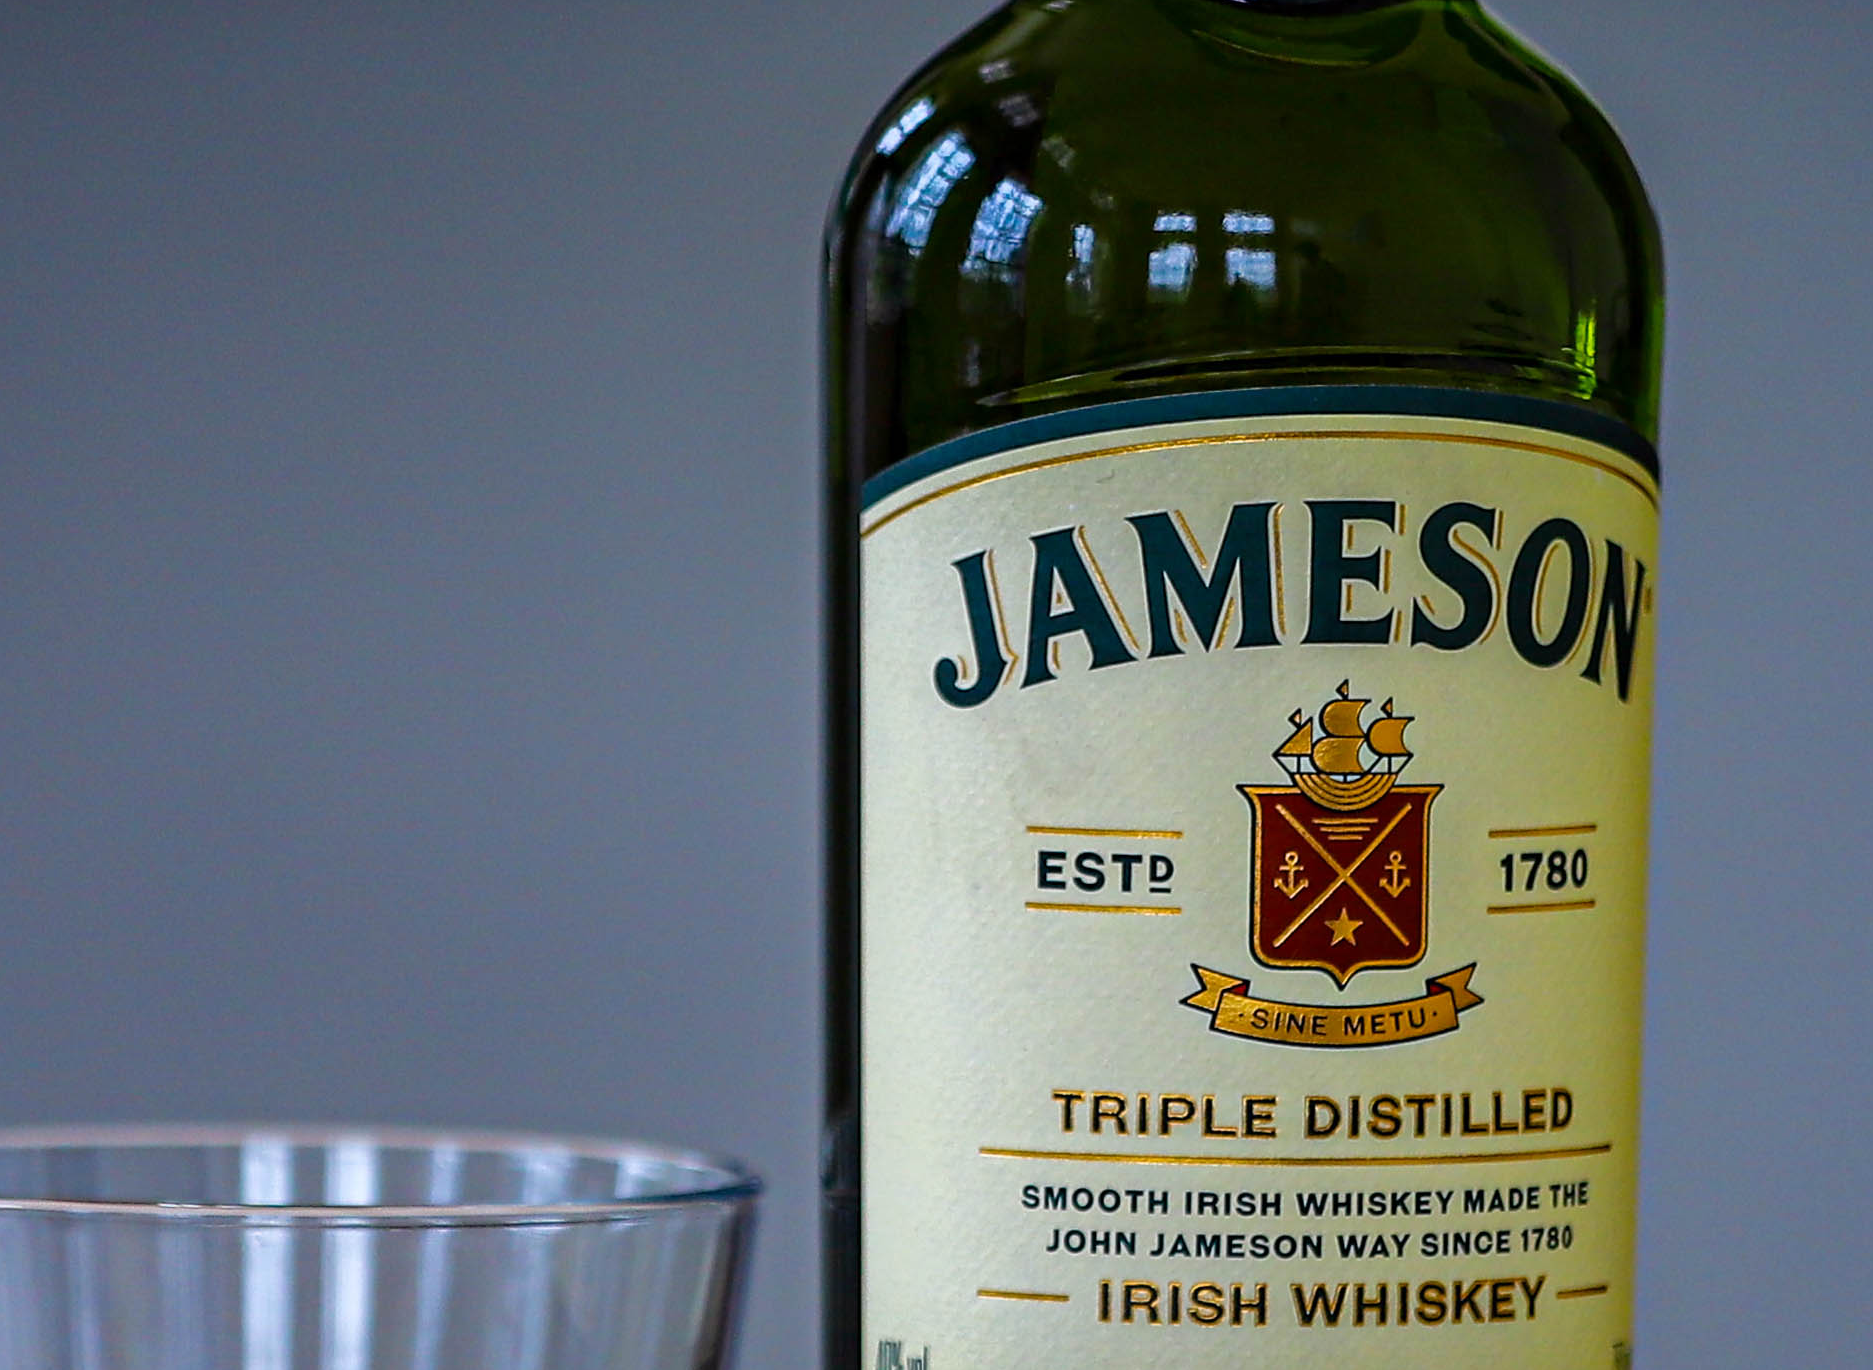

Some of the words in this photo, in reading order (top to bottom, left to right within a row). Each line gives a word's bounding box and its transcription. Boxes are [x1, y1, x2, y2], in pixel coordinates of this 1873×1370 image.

[934, 499, 1647, 707] JAMESON
[1500, 849, 1588, 891] 1780
[1250, 1008, 1328, 1036] SINE
[1343, 1008, 1427, 1036] METU
[1052, 1089, 1277, 1139] TRIPLE
[1304, 1087, 1574, 1139] DISTILLED
[1022, 1184, 1169, 1216] SMOOTH
[1185, 1191, 1282, 1217] IRISH
[1296, 1190, 1454, 1217] WHISKEY
[1463, 1186, 1541, 1213] MADE
[1549, 1182, 1589, 1207] THE
[1046, 1229, 1137, 1256] JOHN
[1150, 1232, 1324, 1259] JAMESON
[1337, 1234, 1411, 1259] WAY
[1421, 1230, 1510, 1257] SINCE
[1520, 1225, 1573, 1252] 1780
[1098, 1278, 1269, 1327] IRISH
[1290, 1275, 1546, 1327] WHISKEY
